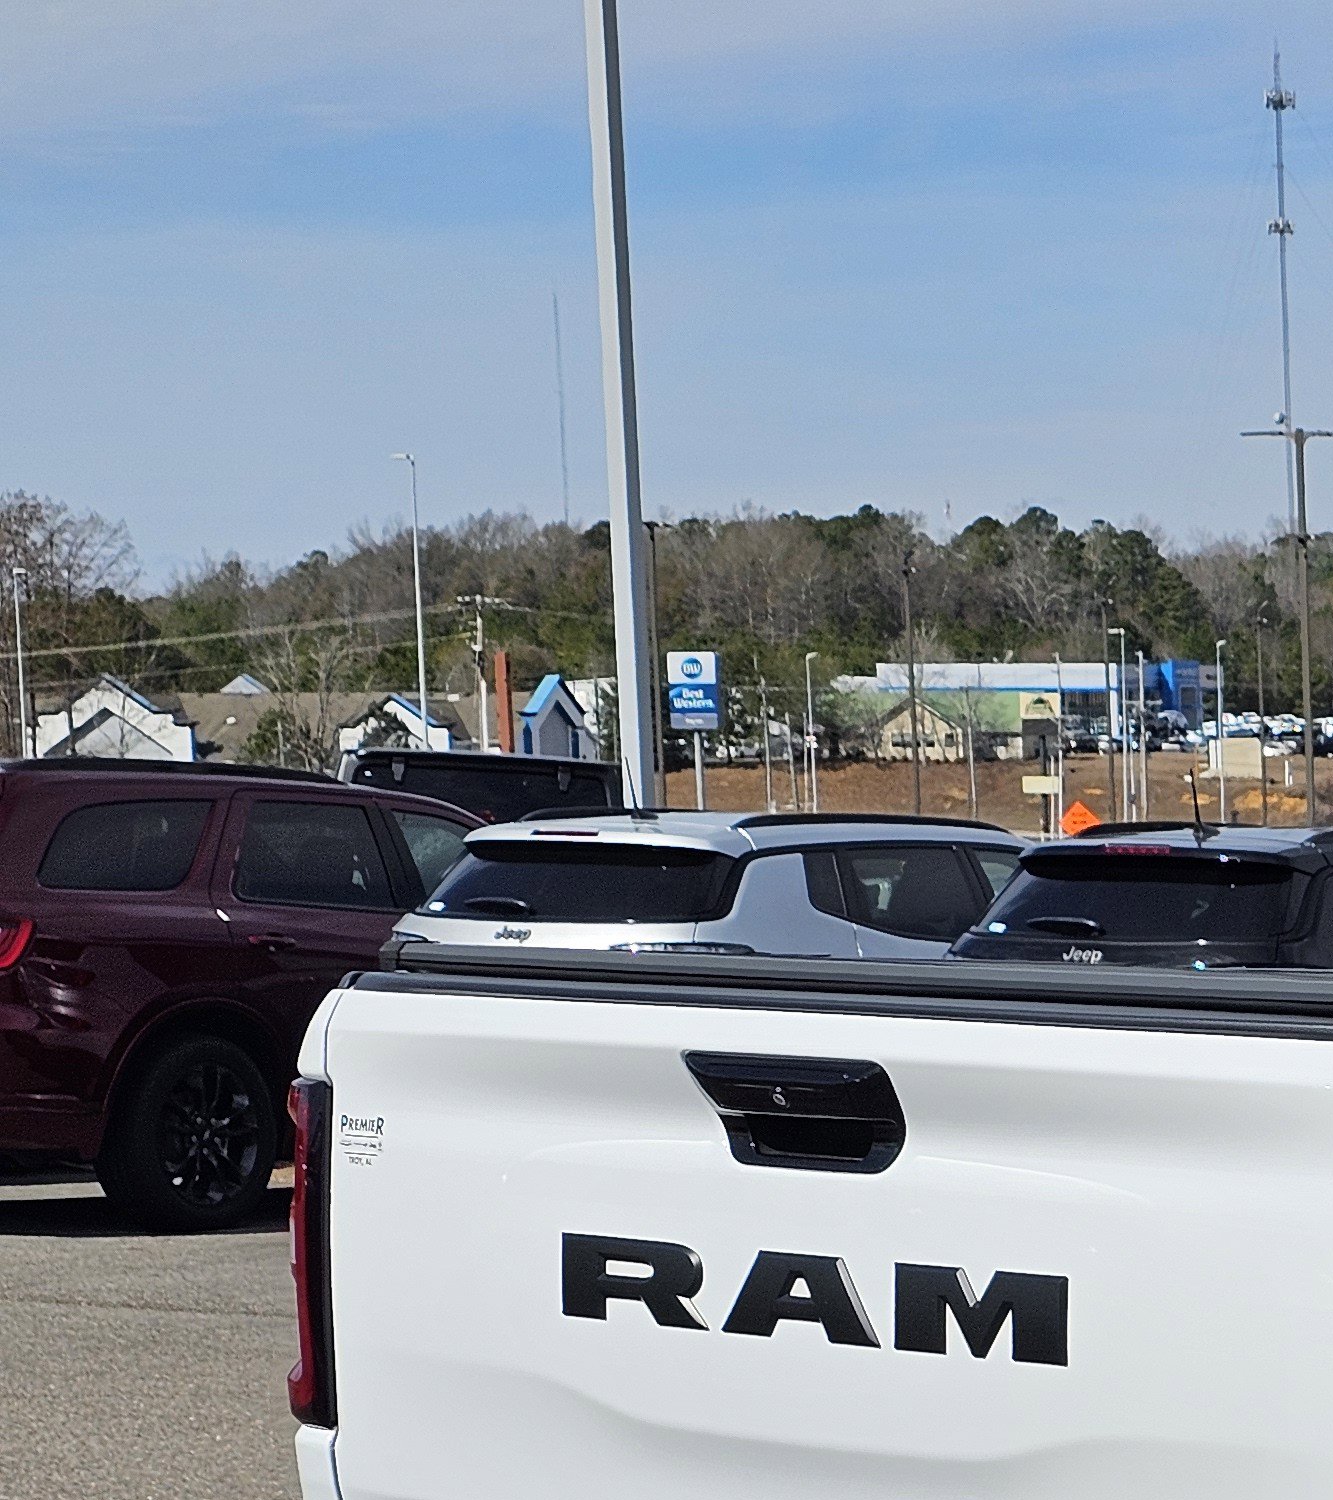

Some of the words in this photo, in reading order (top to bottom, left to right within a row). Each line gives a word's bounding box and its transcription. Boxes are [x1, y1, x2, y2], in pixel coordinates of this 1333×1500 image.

[494, 926, 531, 944] Jeep
[1062, 945, 1103, 965] Jeep
[340, 1114, 385, 1136] PREMIER
[561, 1232, 1069, 1367] RAM
